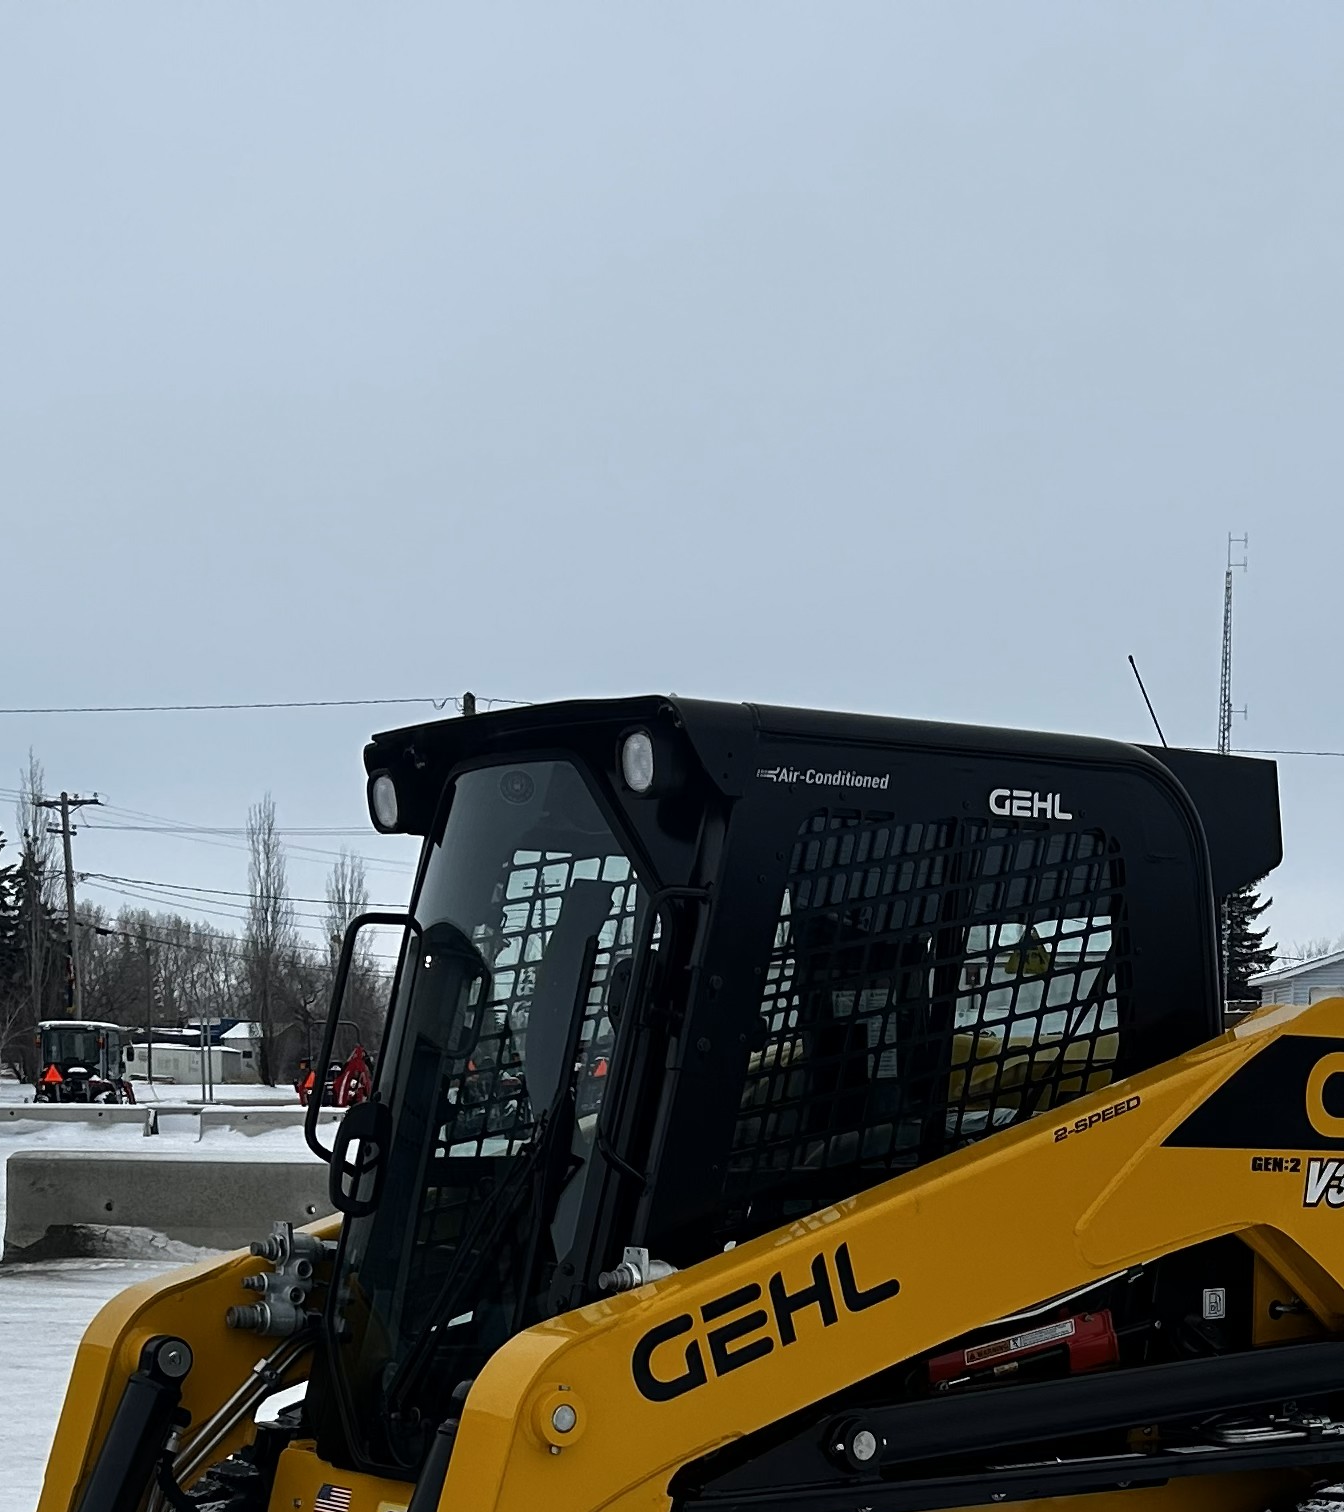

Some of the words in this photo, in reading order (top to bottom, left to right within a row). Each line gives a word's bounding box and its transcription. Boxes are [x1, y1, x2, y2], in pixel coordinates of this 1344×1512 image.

[778, 766, 890, 789] Air-Conditioned
[989, 788, 1073, 820] GEHL
[1054, 1095, 1141, 1143] 2-SPEED
[1251, 1156, 1301, 1172] GEN:2
[632, 1241, 901, 1403] GEHL
